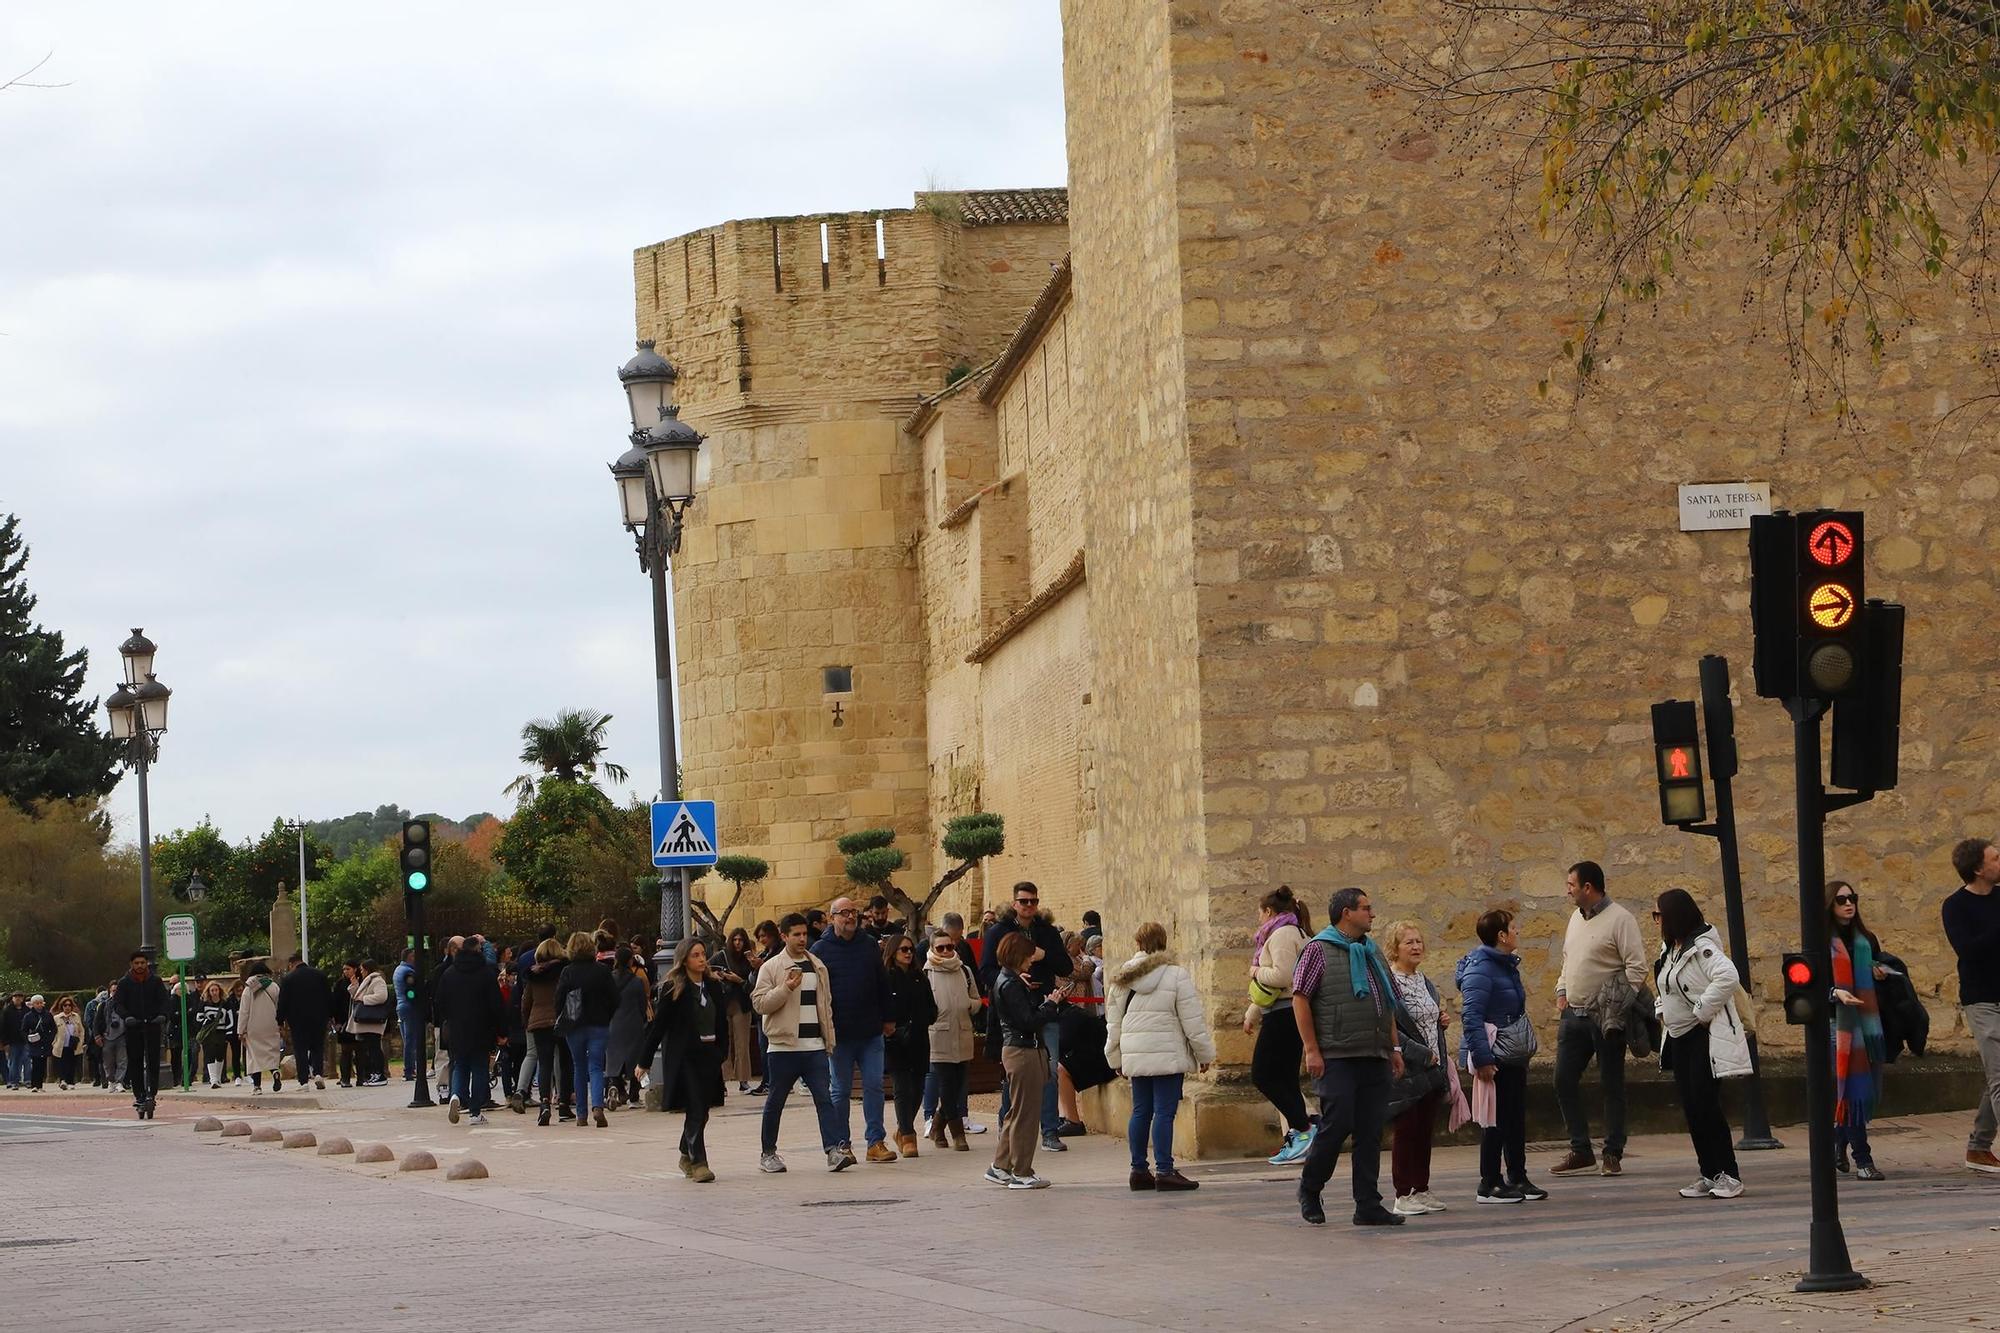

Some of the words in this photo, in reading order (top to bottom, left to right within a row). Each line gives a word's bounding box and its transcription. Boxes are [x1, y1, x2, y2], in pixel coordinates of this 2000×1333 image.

[1687, 494, 1721, 505] SANTA
[1725, 493, 1763, 503] TERESA
[1706, 508, 1744, 519] JORNET
